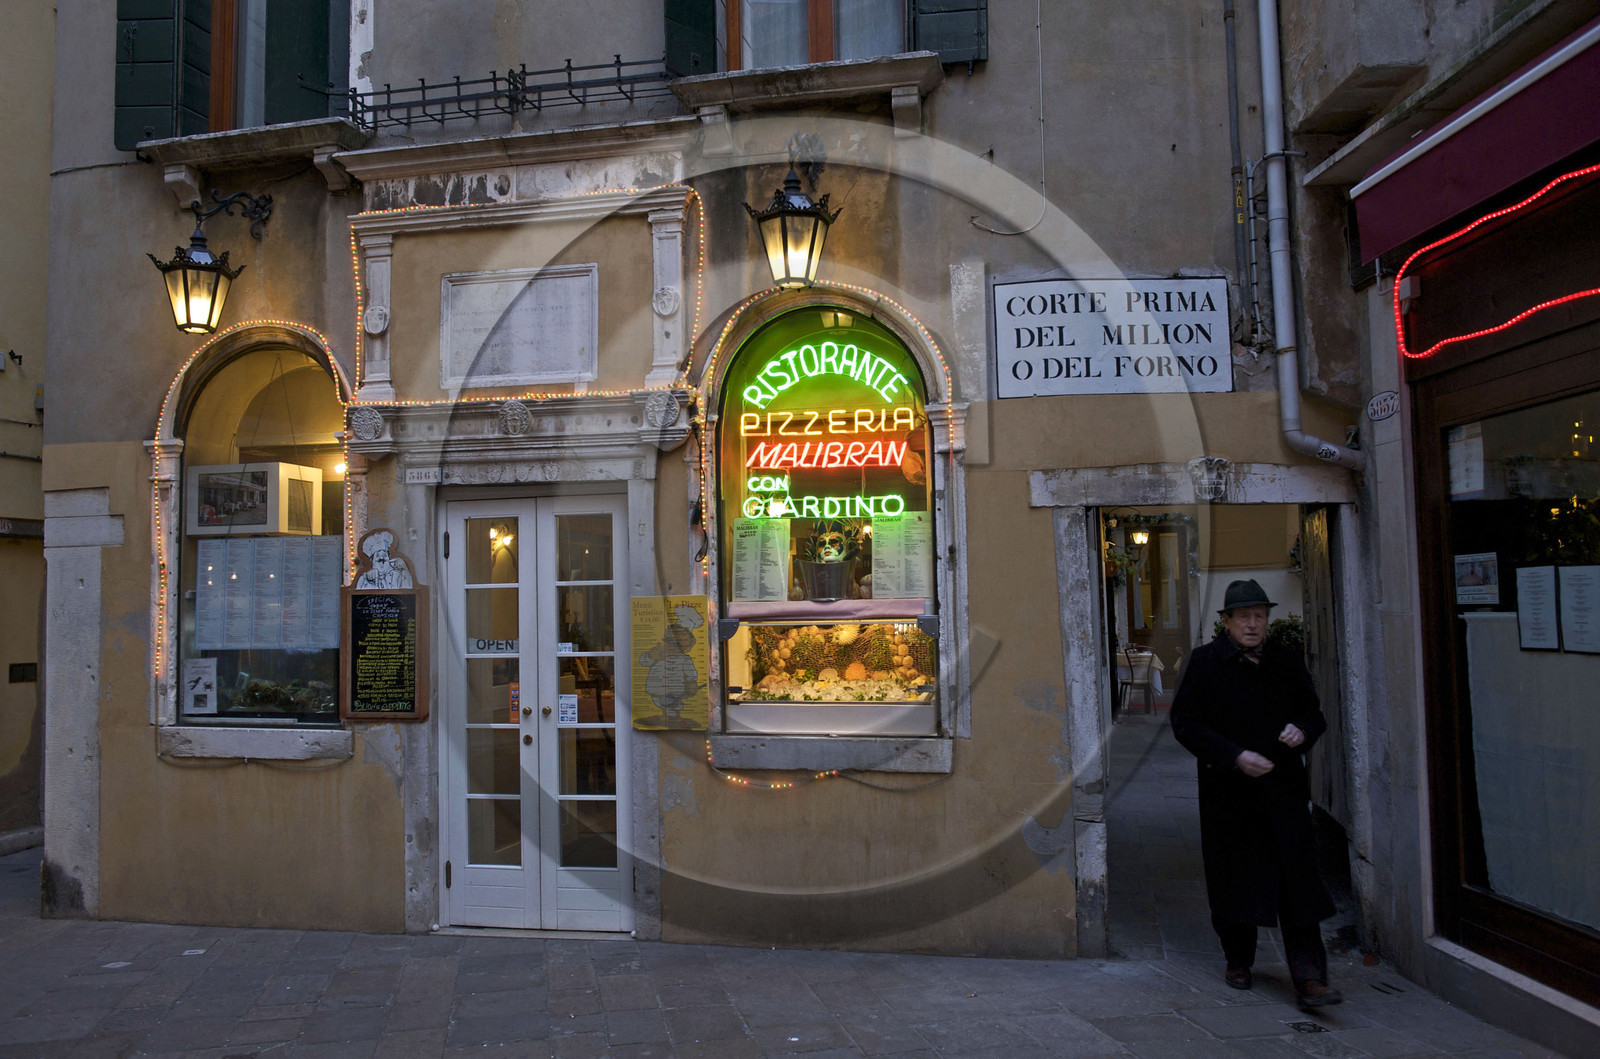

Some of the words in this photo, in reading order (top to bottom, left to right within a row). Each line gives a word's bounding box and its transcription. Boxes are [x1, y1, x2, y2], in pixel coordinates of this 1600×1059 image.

[1006, 291, 1107, 317] CORTE
[1126, 290, 1217, 313] PRIMA
[1015, 325, 1076, 349] DEL
[1102, 323, 1213, 346] MILION
[743, 341, 909, 410] RISTORANTE
[1011, 359, 1033, 380] O
[1043, 356, 1102, 379] DEL
[1114, 354, 1218, 378] FORNO
[740, 407, 915, 437] PIZZERIA
[745, 441, 908, 468] MALIBRAN
[408, 471, 438, 481] 5864
[747, 475, 789, 492] CON
[742, 494, 905, 519] GIARDINO
[681, 600, 702, 608] Pizze
[476, 639, 514, 651] OPEN
